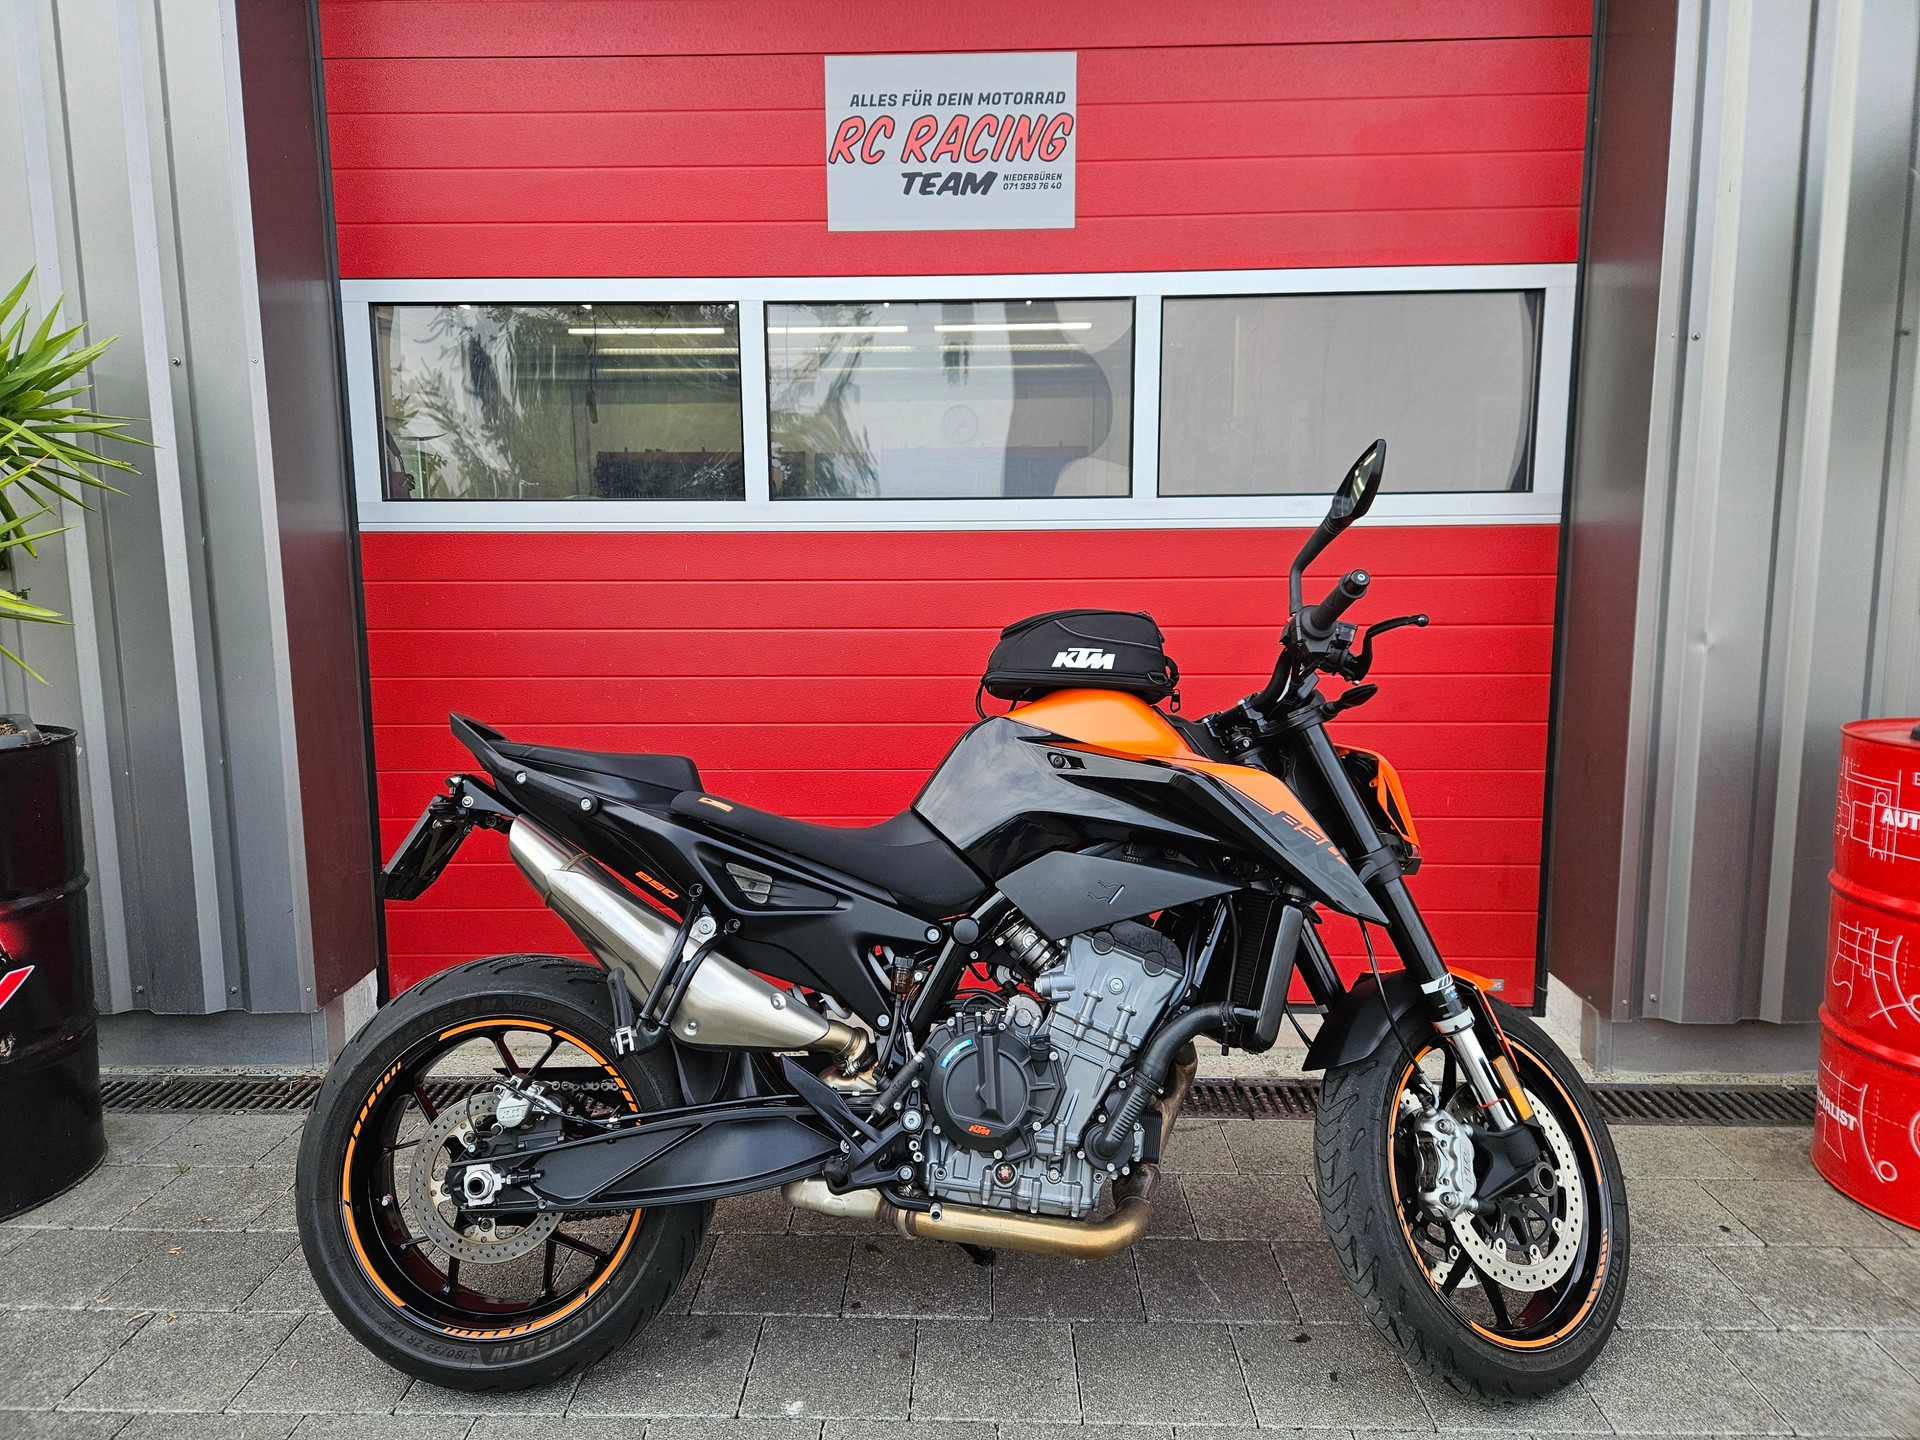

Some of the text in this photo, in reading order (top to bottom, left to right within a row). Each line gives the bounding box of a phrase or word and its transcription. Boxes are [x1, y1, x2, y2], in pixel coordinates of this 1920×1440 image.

[850, 89, 1066, 107] ALLES FÜR DEIN MOTORRAD
[828, 112, 1074, 165] RC RACING
[901, 170, 998, 196] TEAM
[1003, 171, 1063, 181] NIEDERBÜREN
[1003, 182, 1018, 190] 071
[1038, 182, 1049, 190] 76
[1051, 182, 1062, 190] 40
[1051, 647, 1116, 670] KTM
[968, 1123, 991, 1136] KTM
